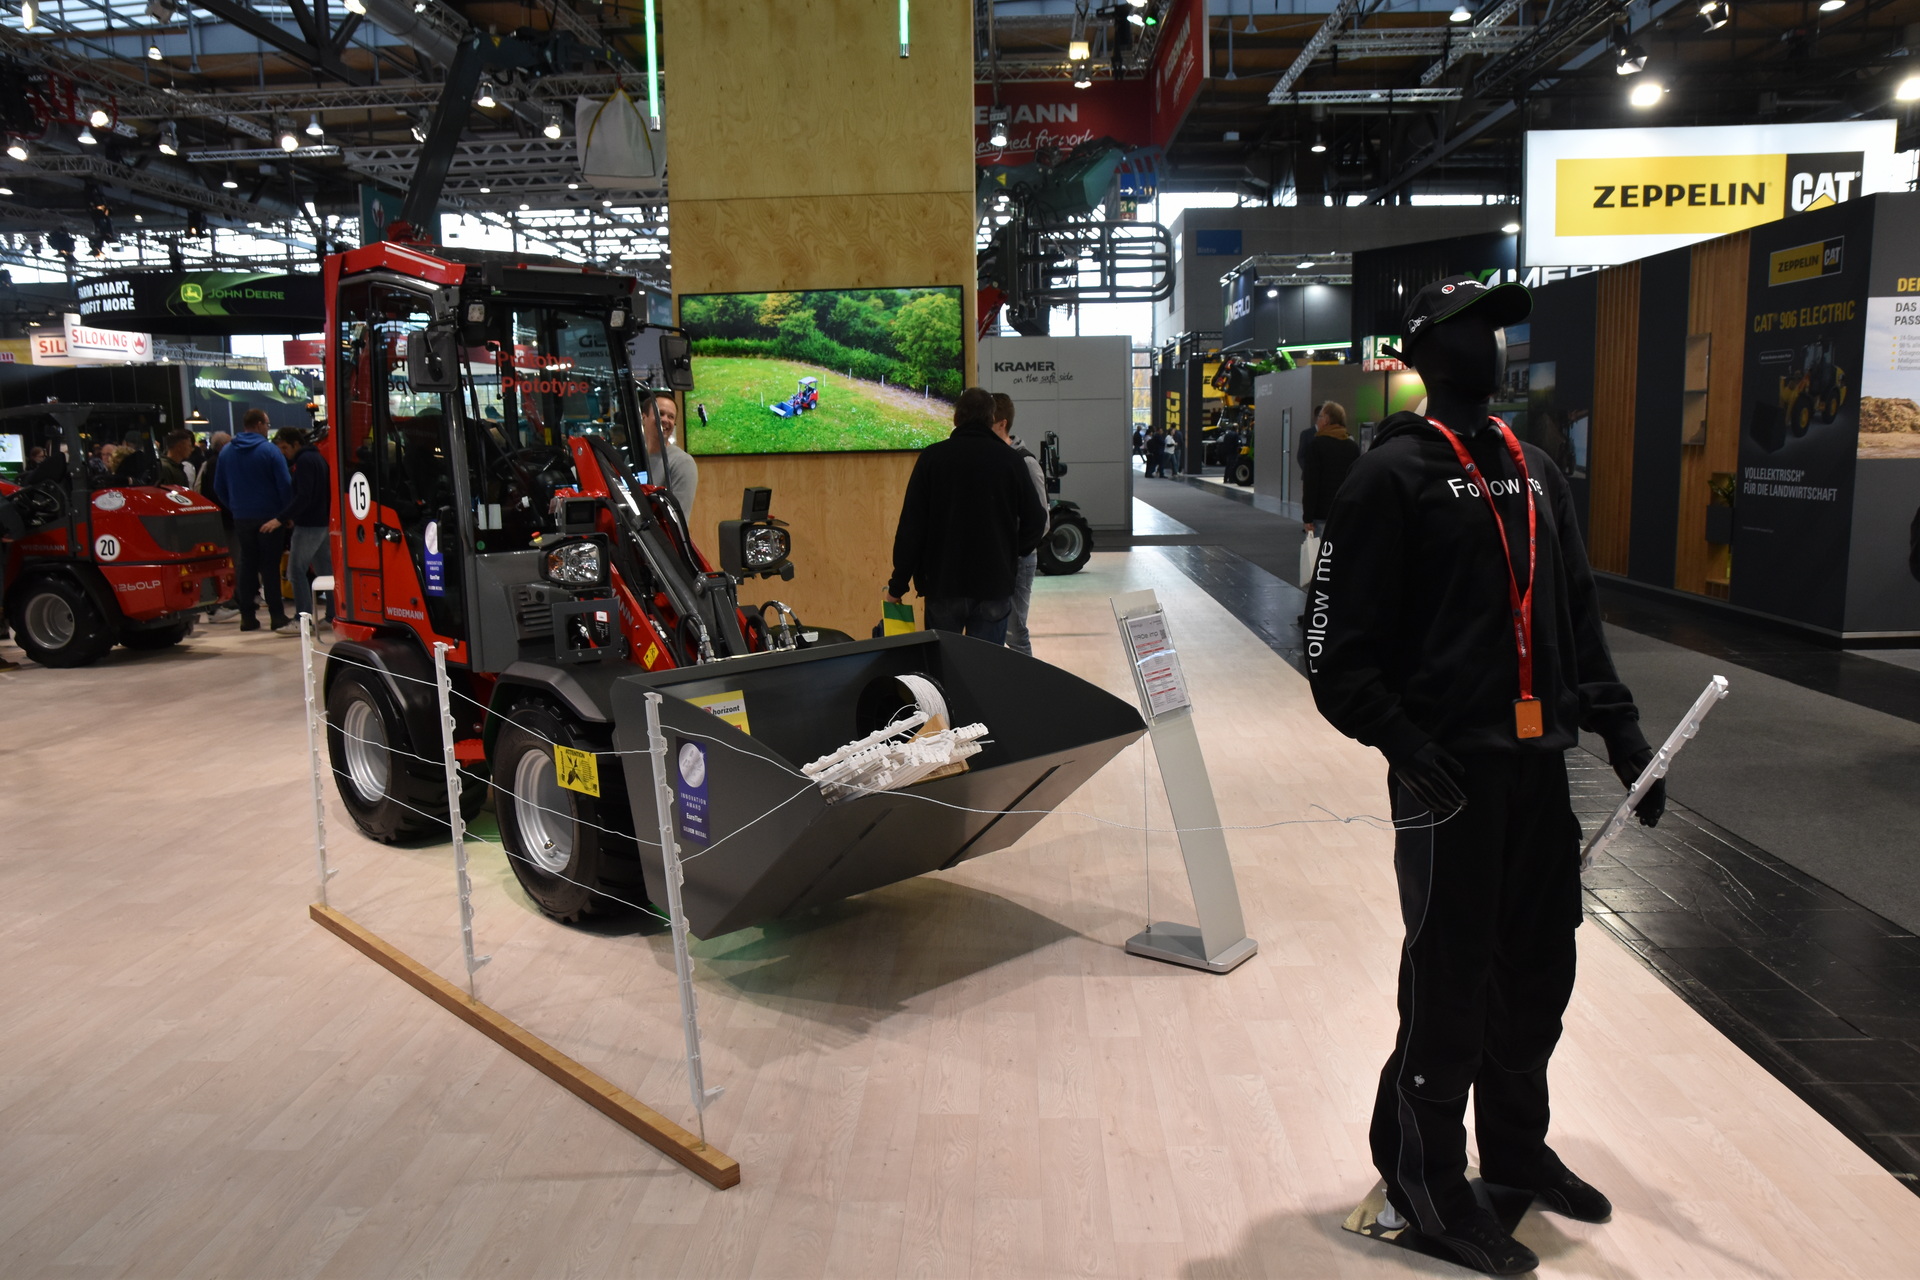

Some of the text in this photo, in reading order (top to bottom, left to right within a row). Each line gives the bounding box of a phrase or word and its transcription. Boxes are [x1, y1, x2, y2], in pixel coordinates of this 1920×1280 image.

[1593, 171, 1856, 212] ZEPPELIN CAT
[1778, 246, 1842, 273] ZEPPELIN CAT
[94, 280, 135, 297] SMART,
[208, 288, 285, 300] JOHN DEERE
[102, 297, 136, 312] MORE
[1895, 302, 1917, 313] DAS
[1780, 310, 1798, 330] 906
[1800, 300, 1856, 327] ELECTRIC
[72, 329, 128, 347] SILOKING
[39, 340, 68, 354] SIL
[994, 361, 1056, 372] KRAMER
[1025, 373, 1039, 383] the
[1041, 371, 1056, 384] safe
[1058, 372, 1074, 382] side
[501, 375, 590, 398] Prototype
[1447, 477, 1520, 498] Folow
[1743, 479, 1838, 502] FÜR DIE LANDWIRTSCHAFT
[353, 481, 366, 511] 15
[100, 539, 116, 557] 20
[1317, 541, 1333, 581] me
[386, 606, 425, 620] WEIDEMANN
[712, 704, 741, 716] horizont
[680, 792, 707, 806] INNOVATION
[686, 801, 702, 811] AWARD
[686, 812, 703, 824] EuroTier
